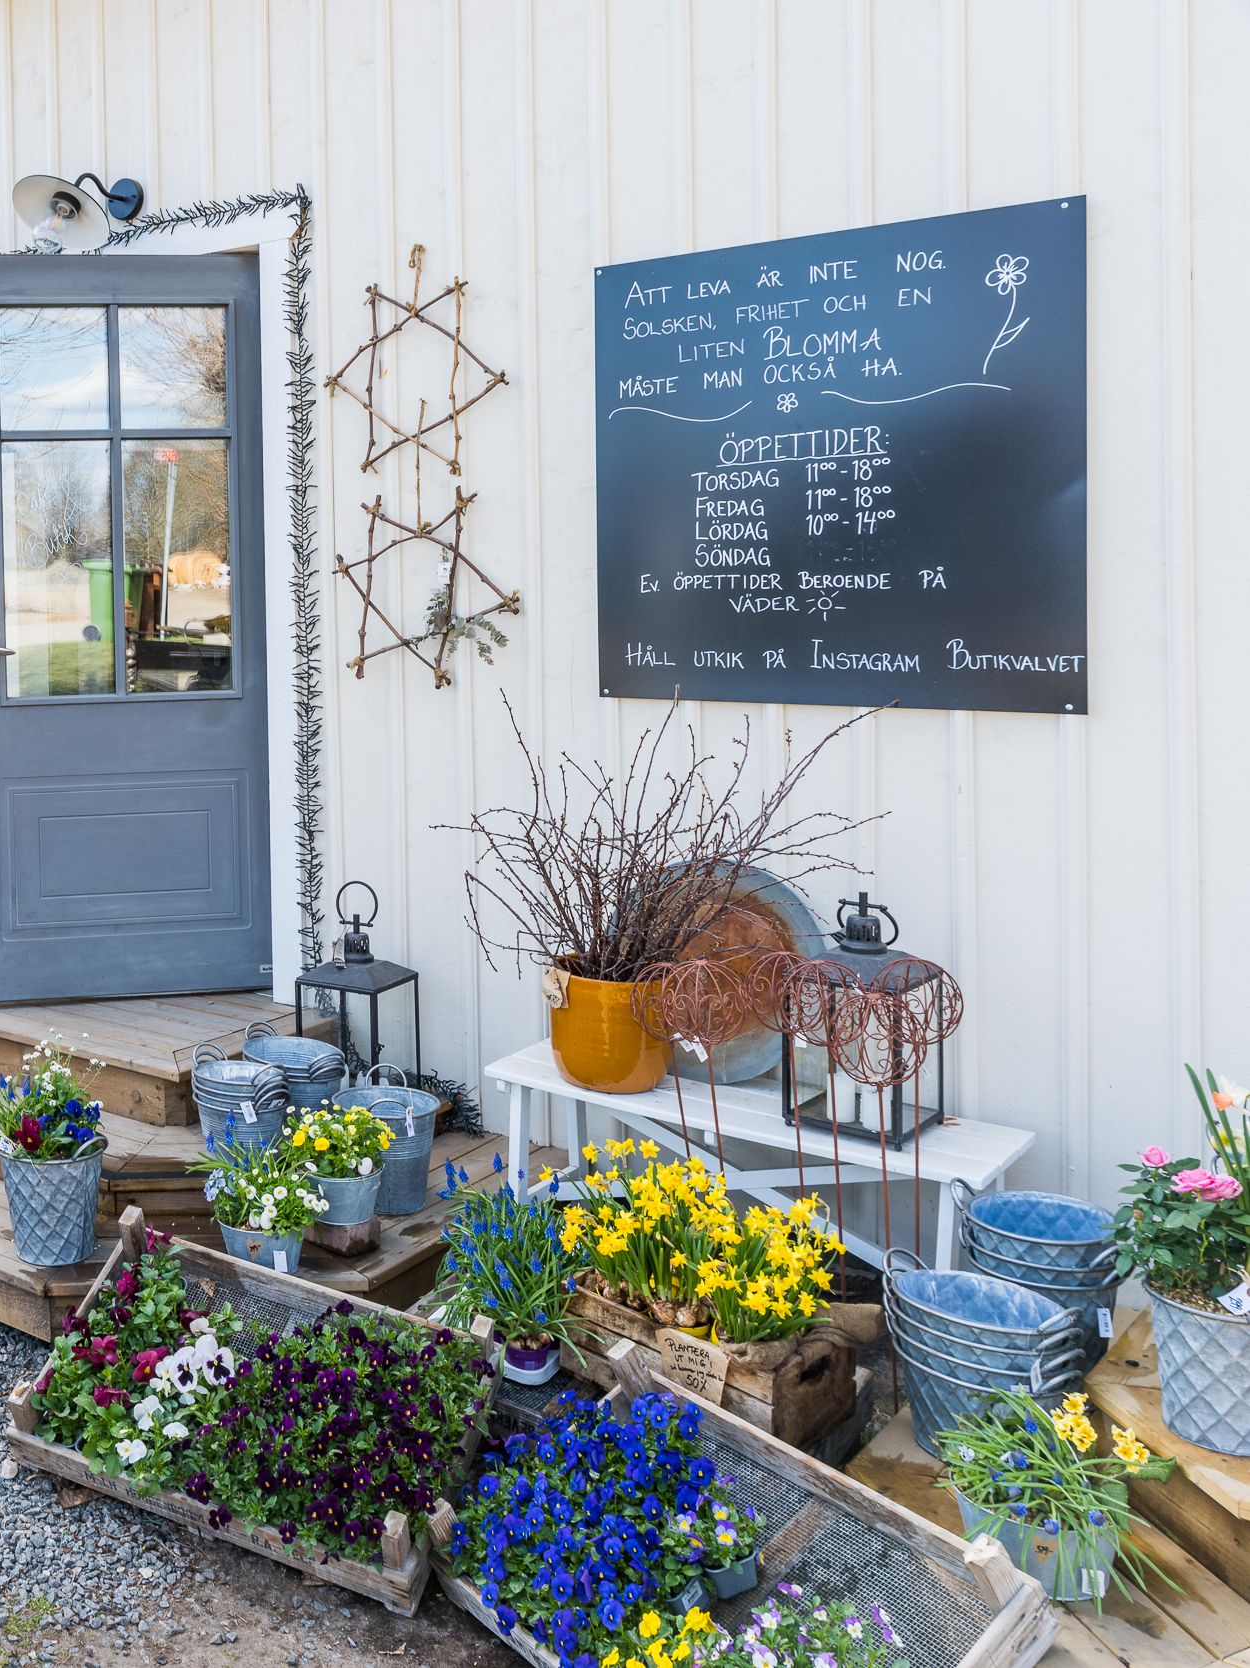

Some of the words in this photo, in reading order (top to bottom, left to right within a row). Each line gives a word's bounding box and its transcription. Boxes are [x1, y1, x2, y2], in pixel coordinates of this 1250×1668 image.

[624, 281, 672, 308] ATT
[687, 280, 731, 301] LEVA
[756, 265, 784, 288] ÄR
[809, 259, 858, 284] INTE
[896, 250, 946, 273] NOG.
[622, 315, 717, 341] SOLSKEN,
[735, 299, 810, 325] FRIHET
[823, 293, 867, 314] OCH
[897, 286, 932, 308] EN
[678, 338, 745, 363] LITEN
[763, 325, 882, 361] BLOMMA
[618, 374, 678, 399] MÅSTE
[703, 367, 743, 389] MAN
[763, 356, 836, 385] OCKSÅ
[861, 357, 903, 377] HA.
[718, 425, 890, 466] ÖPPETTIDER:
[691, 468, 780, 491] TORSDAG
[695, 496, 765, 518] FREDAG
[25, 520, 88, 568] Butik
[695, 519, 769, 541] LÖRDAG
[695, 543, 771, 567] SÖNDAG
[673, 569, 783, 591] ÖPPETTIDER
[798, 571, 892, 591] BEROENDE
[918, 566, 948, 590] PÅ
[729, 595, 800, 613] VÄDER
[624, 642, 677, 667] HÅLL
[693, 649, 745, 670] UTKIK
[762, 647, 787, 670] PÅ
[810, 638, 920, 673] INSTAGRAM
[946, 638, 1085, 674] BUTIKVALVET
[664, 1338, 710, 1360] PLANTERA
